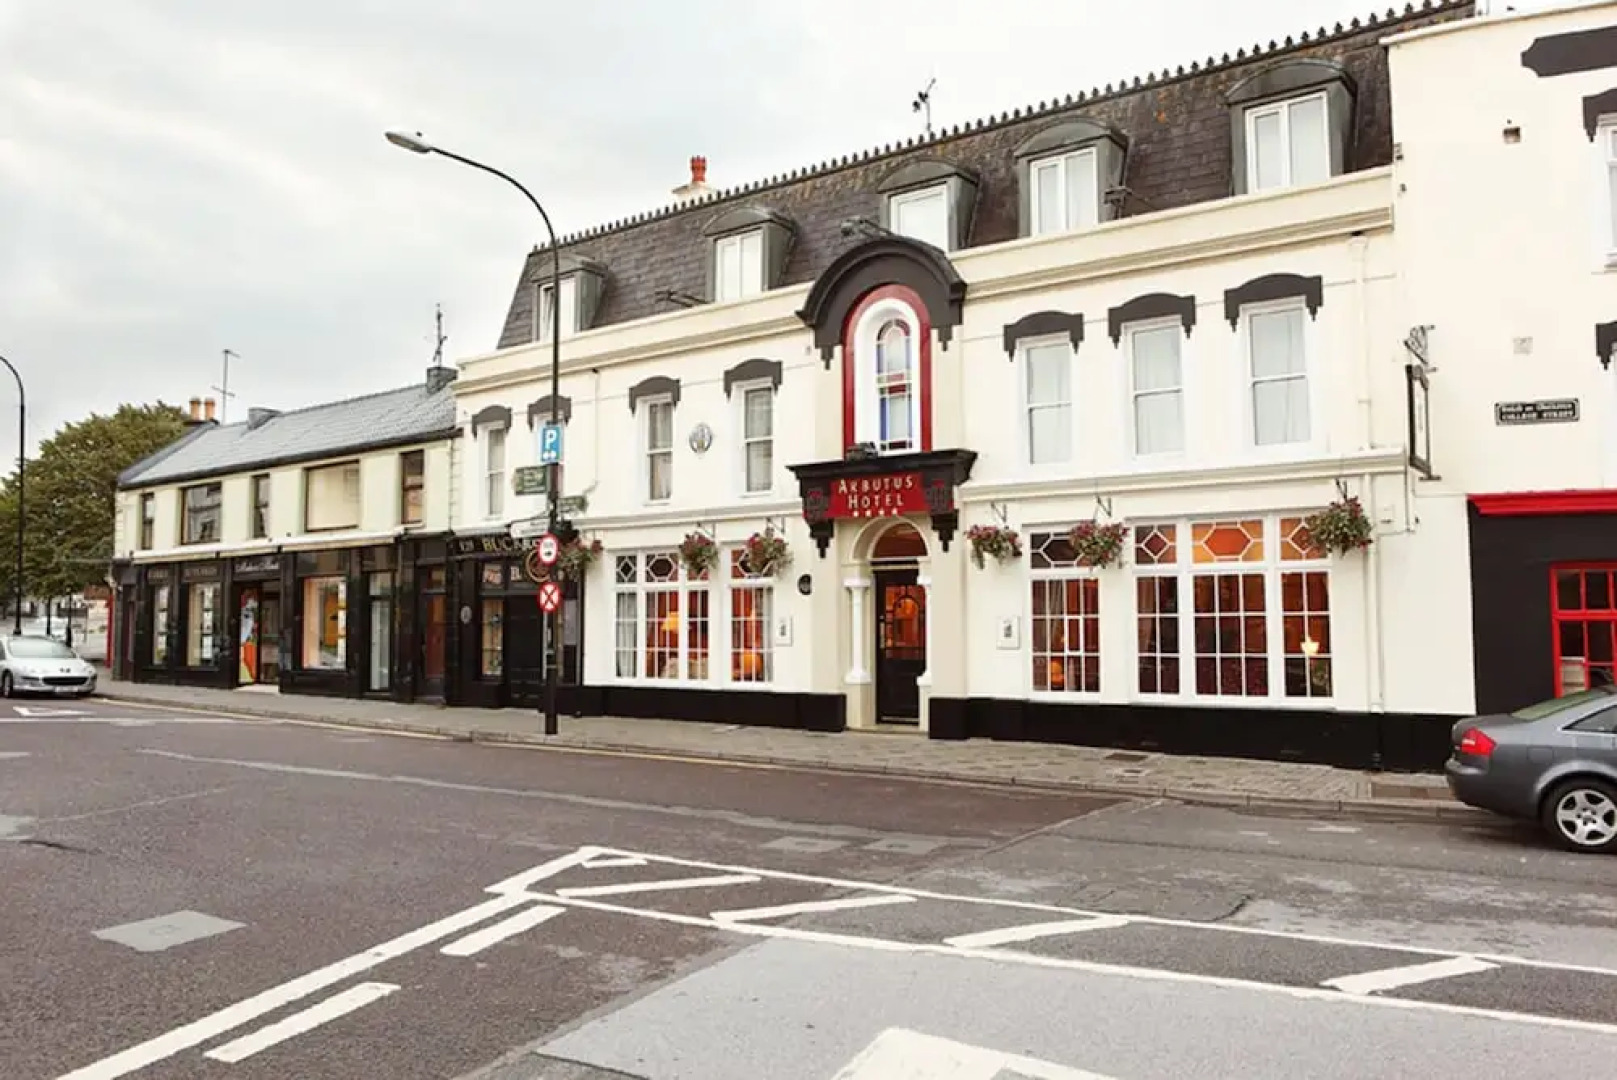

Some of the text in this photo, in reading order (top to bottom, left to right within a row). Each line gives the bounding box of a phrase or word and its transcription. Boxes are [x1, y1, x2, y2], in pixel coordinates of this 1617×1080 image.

[544, 429, 557, 449] P
[838, 474, 913, 494] ARBUTUS
[848, 493, 905, 509] HOTEL
